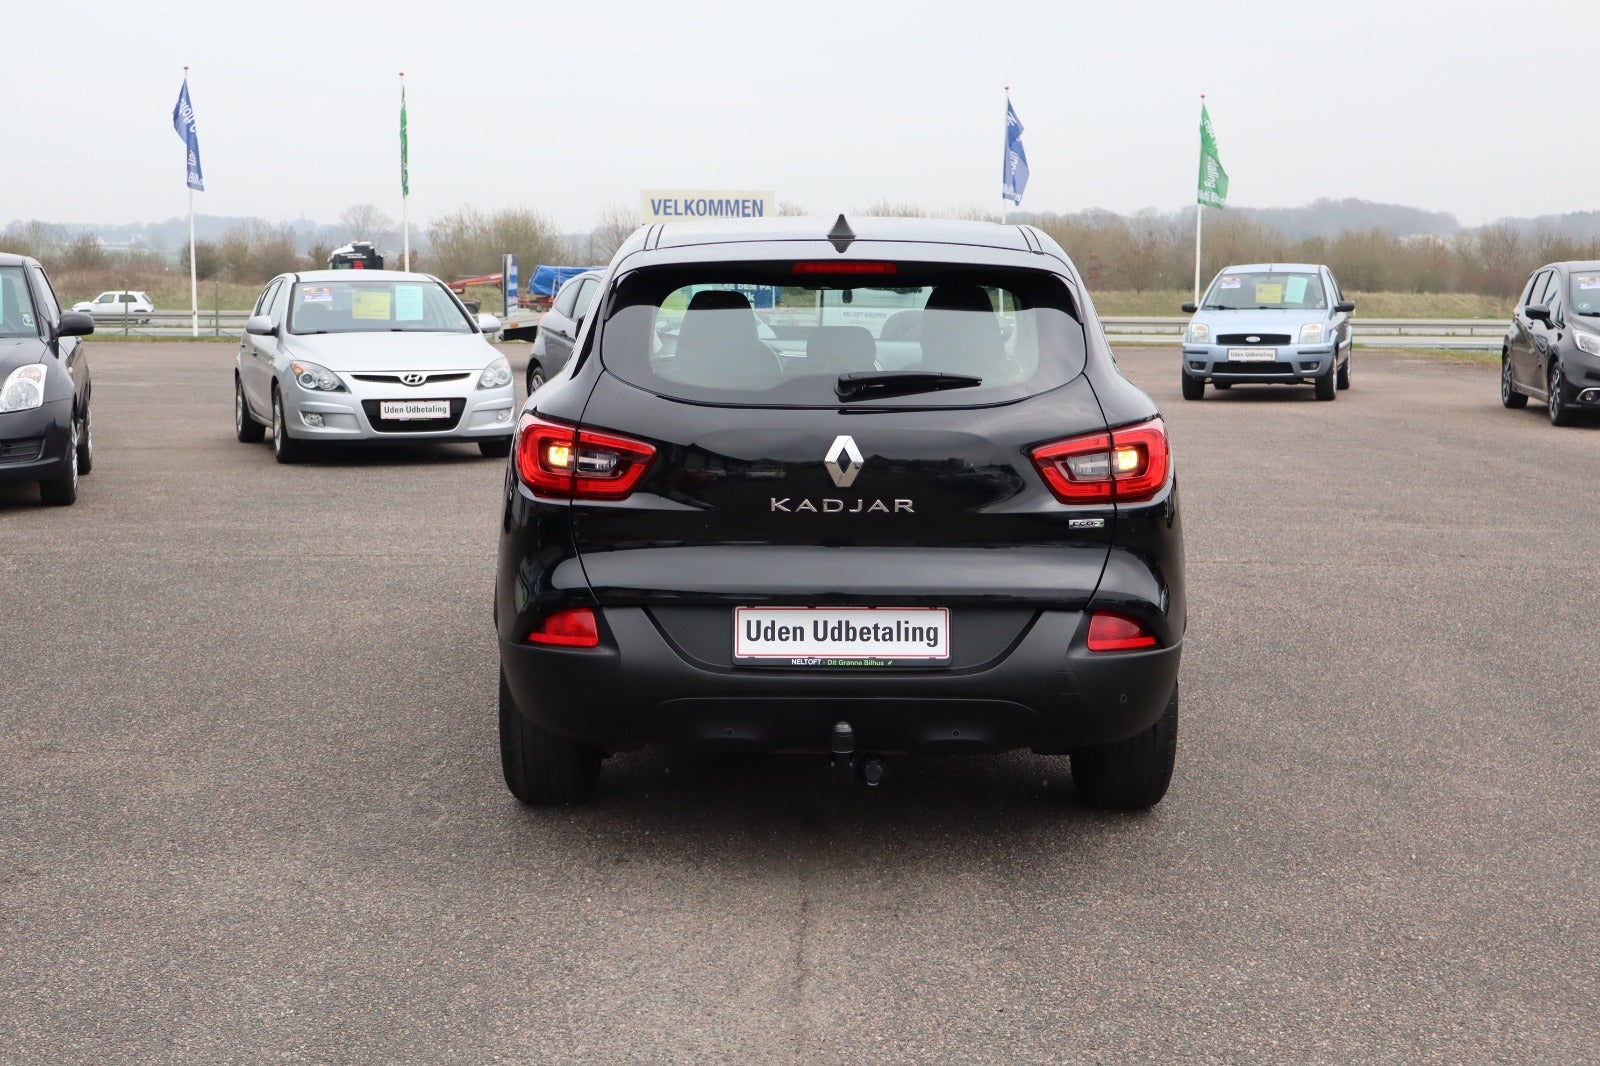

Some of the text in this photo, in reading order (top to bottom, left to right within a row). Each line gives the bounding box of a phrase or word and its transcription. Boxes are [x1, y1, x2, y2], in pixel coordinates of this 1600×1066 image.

[651, 199, 764, 218] VELKOMMEN
[384, 405, 447, 414] Uden Udbetaling
[770, 497, 915, 513] KADJAR
[746, 620, 938, 648] Uden Udbetaling
